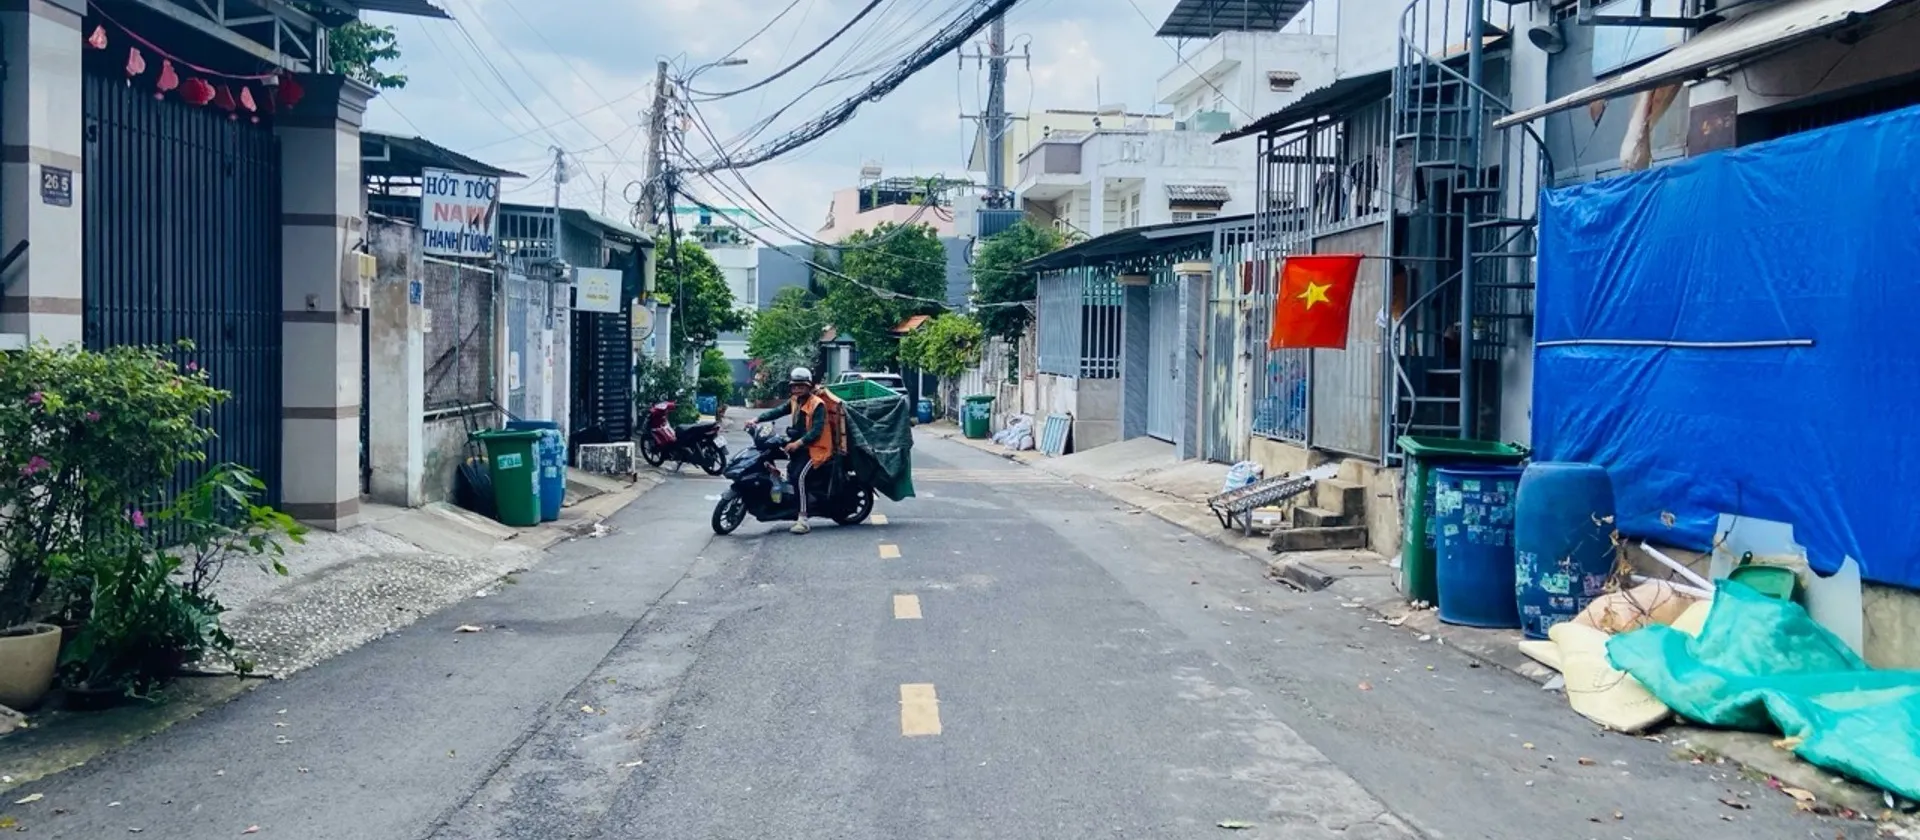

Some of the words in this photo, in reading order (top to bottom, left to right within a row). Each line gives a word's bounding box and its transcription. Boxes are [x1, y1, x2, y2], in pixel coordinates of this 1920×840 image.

[434, 203, 485, 224] NAM
[422, 229, 459, 250] THANH
[464, 229, 493, 253] TÙNG
